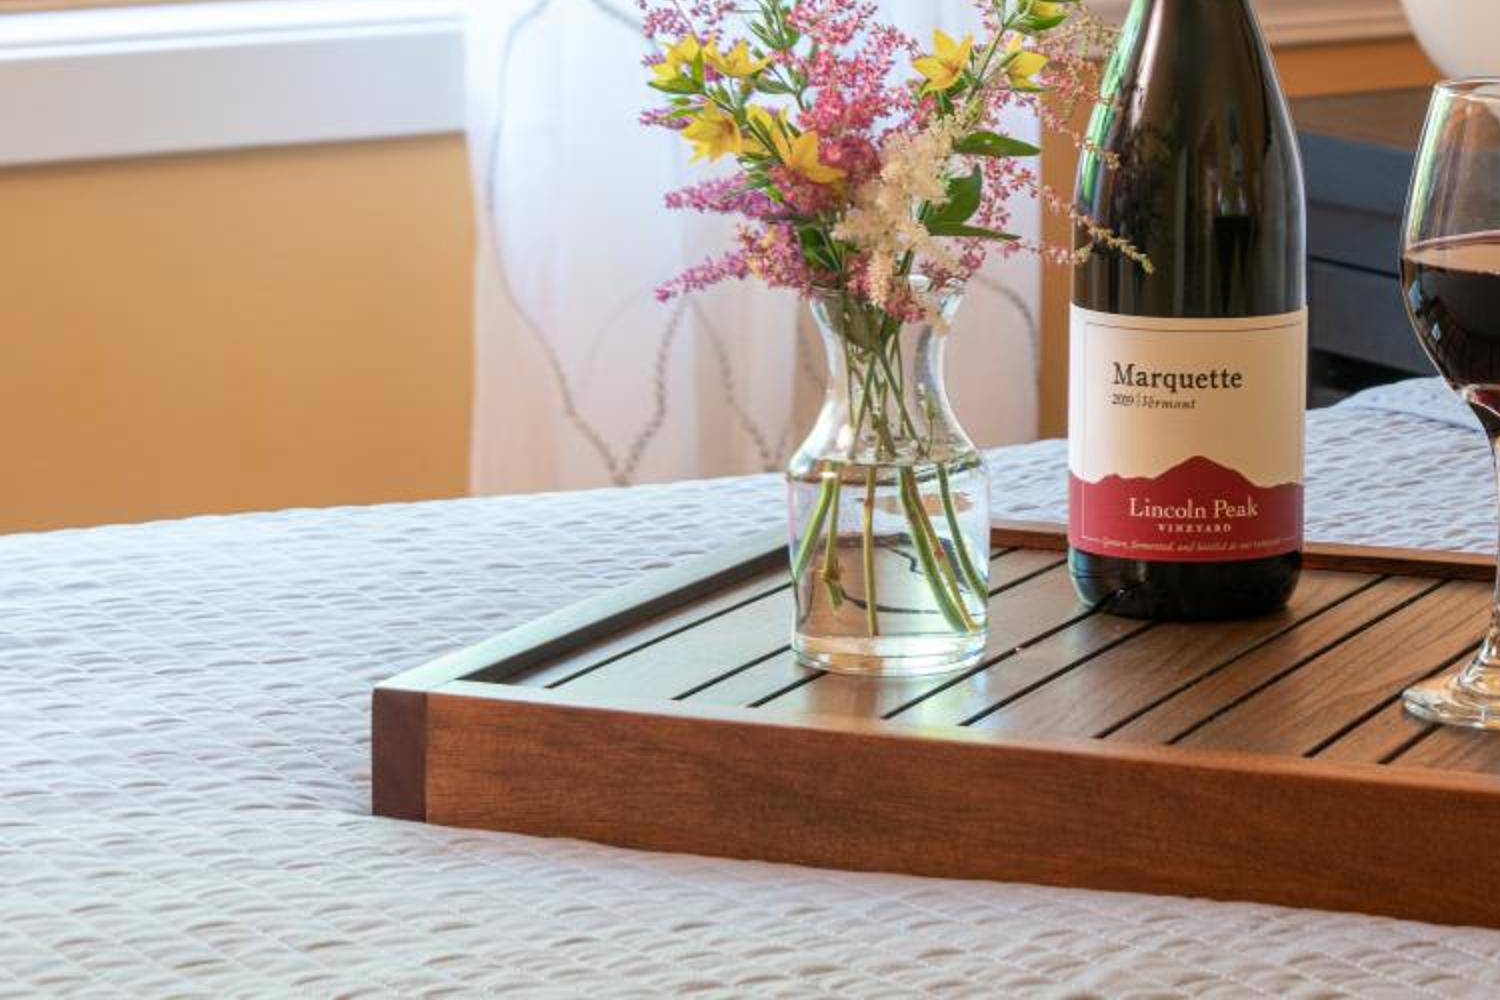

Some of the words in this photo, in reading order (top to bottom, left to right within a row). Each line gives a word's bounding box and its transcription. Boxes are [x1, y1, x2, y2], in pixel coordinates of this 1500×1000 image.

[1111, 361, 1243, 393] Marquette
[1142, 395, 1196, 409] Vermont
[1130, 497, 1207, 519] Lincoln
[1214, 496, 1259, 519] Peak
[1158, 523, 1232, 533] VINEYARD
